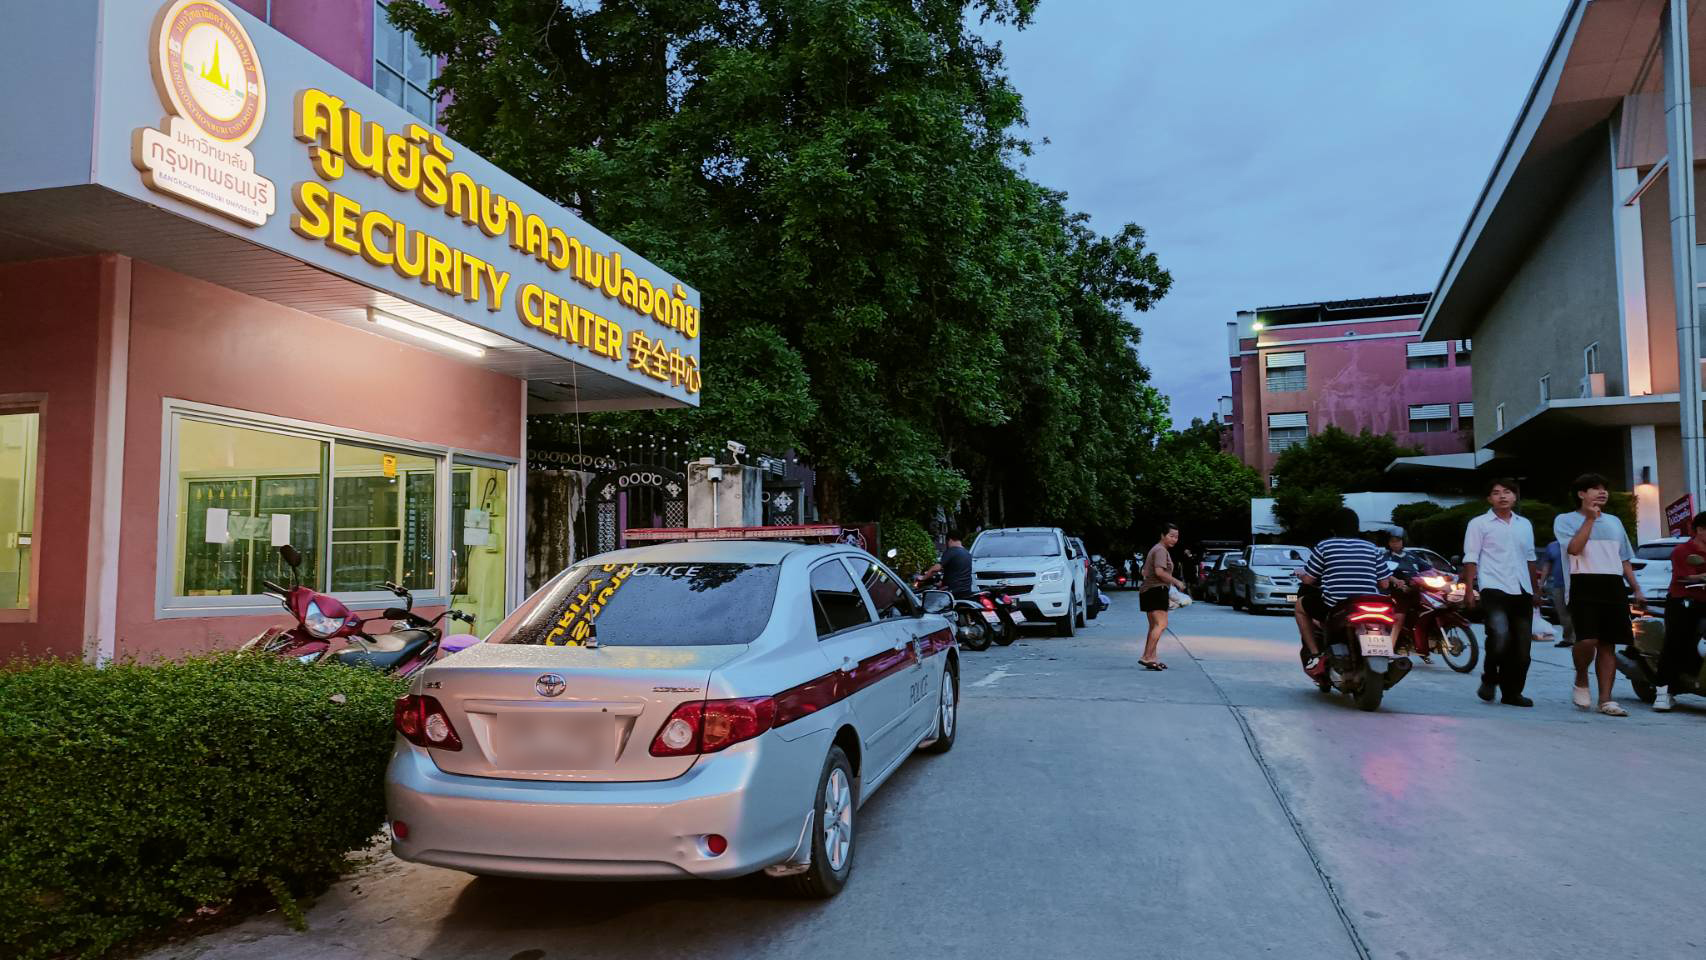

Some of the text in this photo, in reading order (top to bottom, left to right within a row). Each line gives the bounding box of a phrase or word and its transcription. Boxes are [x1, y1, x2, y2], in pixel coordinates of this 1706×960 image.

[152, 142, 268, 206] กรุงเทพธนบุรี
[178, 131, 247, 172] มหาวิทยาลัย
[301, 86, 699, 339] ศูนย์รักษาความปลอดภัย
[297, 180, 623, 361] SECURITY CENTER
[630, 330, 702, 393] 安全中心
